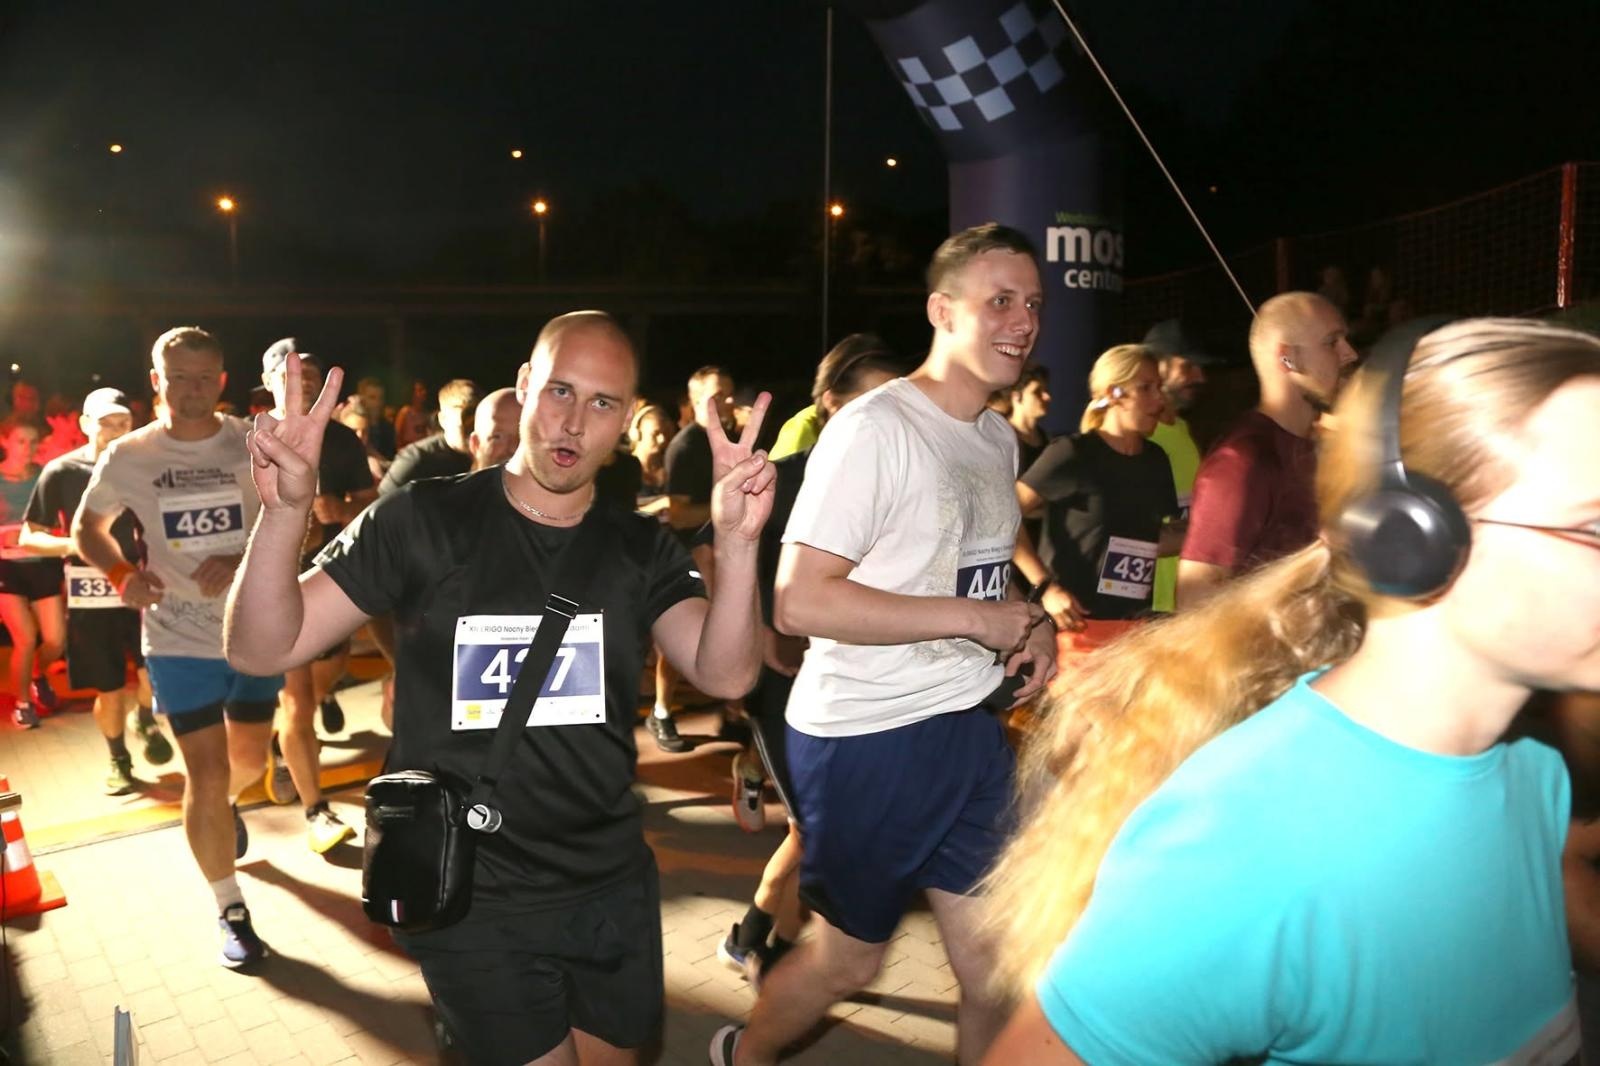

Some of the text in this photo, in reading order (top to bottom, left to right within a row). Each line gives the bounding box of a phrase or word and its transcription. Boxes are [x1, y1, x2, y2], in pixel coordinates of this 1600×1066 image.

[176, 507, 231, 535] 463
[1113, 555, 1154, 583] 432
[504, 625, 524, 634] Nocny
